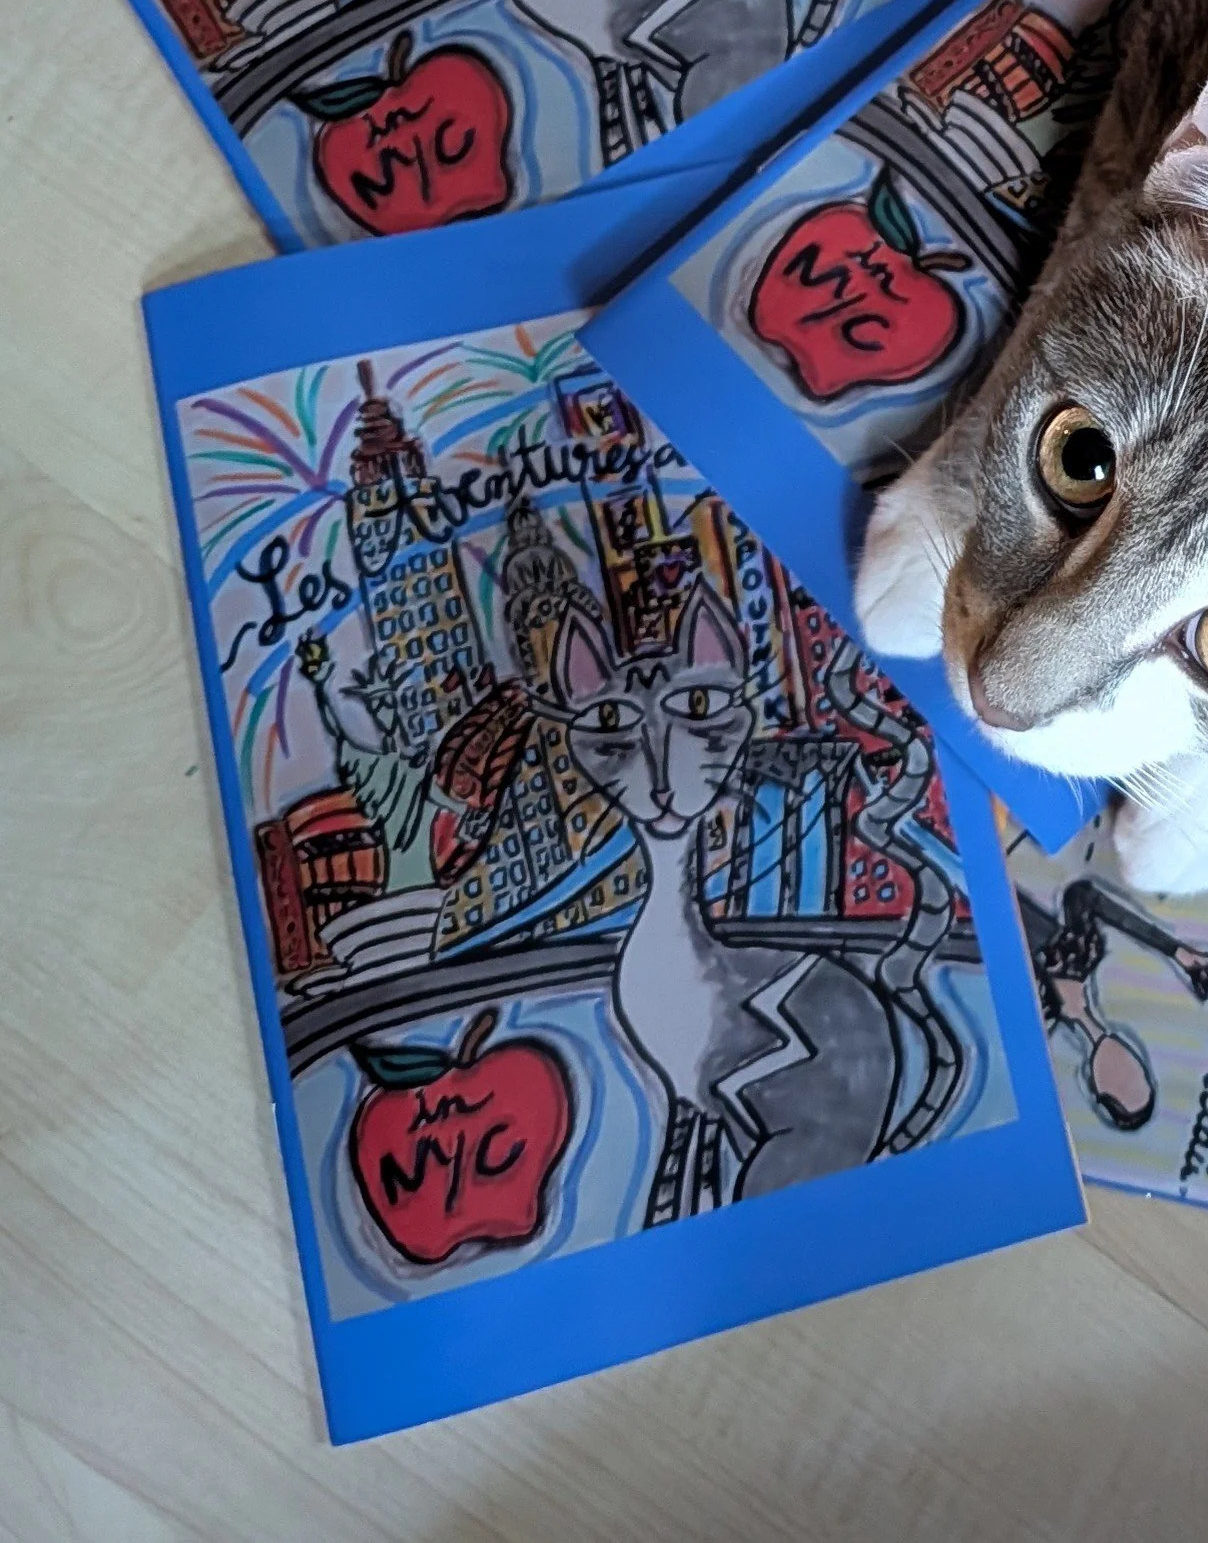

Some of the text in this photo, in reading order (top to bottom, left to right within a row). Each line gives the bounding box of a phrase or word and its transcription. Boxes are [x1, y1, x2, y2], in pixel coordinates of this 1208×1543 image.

[350, 117, 477, 210] NYC
[363, 94, 435, 150] in
[783, 243, 889, 351] NYC
[853, 242, 909, 304] in
[237, 424, 649, 646] Les Aventures
[407, 1089, 496, 1134] in
[379, 1122, 528, 1217] NYC
